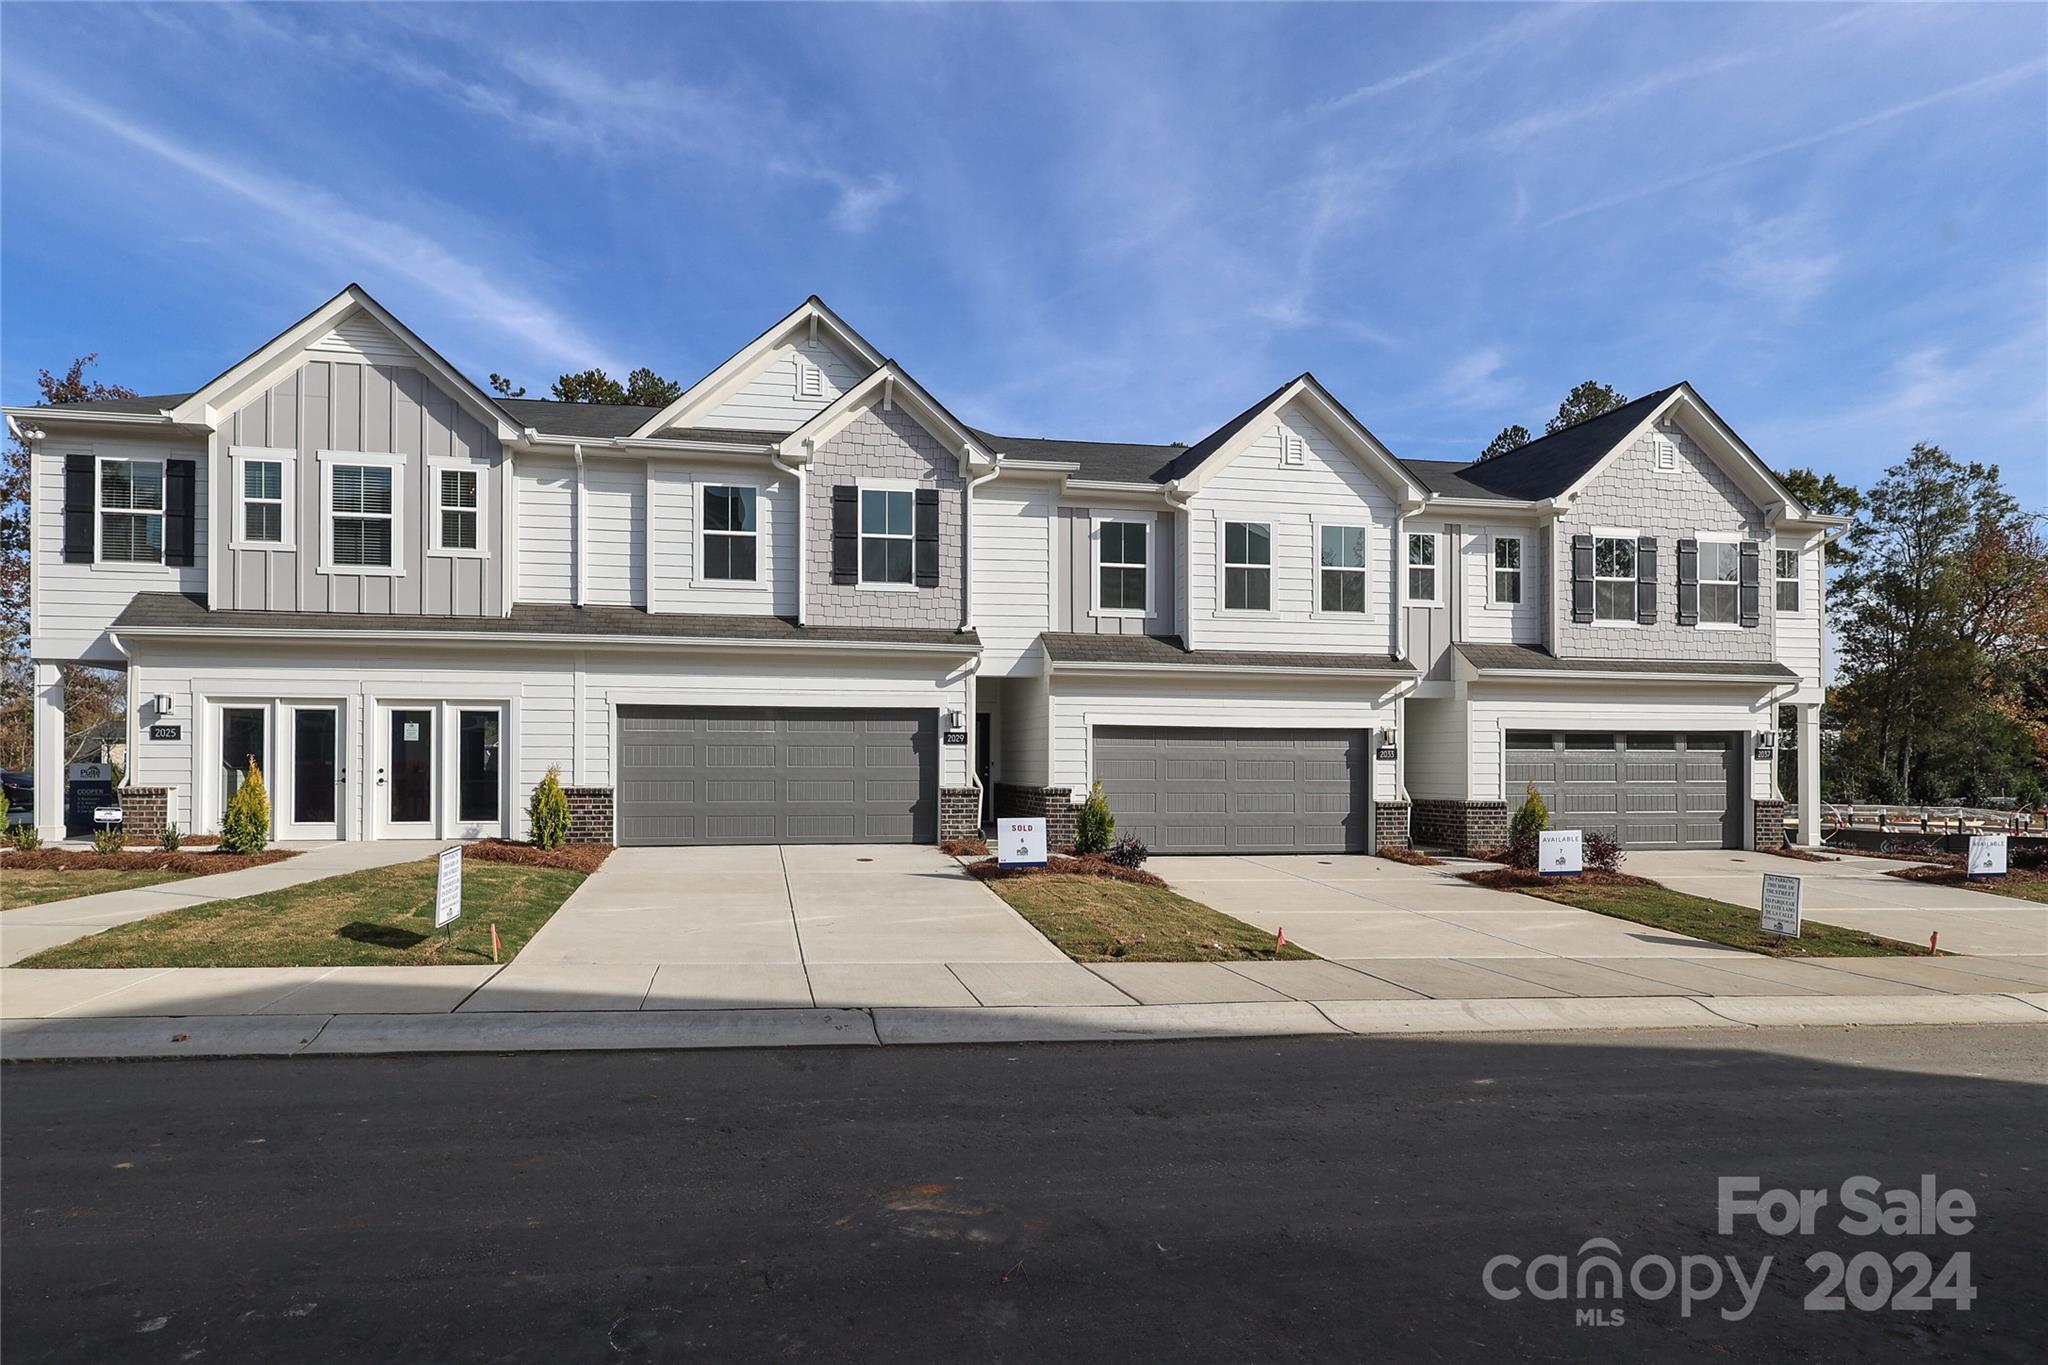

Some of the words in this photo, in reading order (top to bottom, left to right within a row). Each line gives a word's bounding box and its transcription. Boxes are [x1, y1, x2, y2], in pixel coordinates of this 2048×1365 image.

[155, 728, 177, 738] 2025
[947, 734, 965, 743] 2029
[1380, 750, 1395, 758] 2033
[1011, 824, 1033, 832] SOLD
